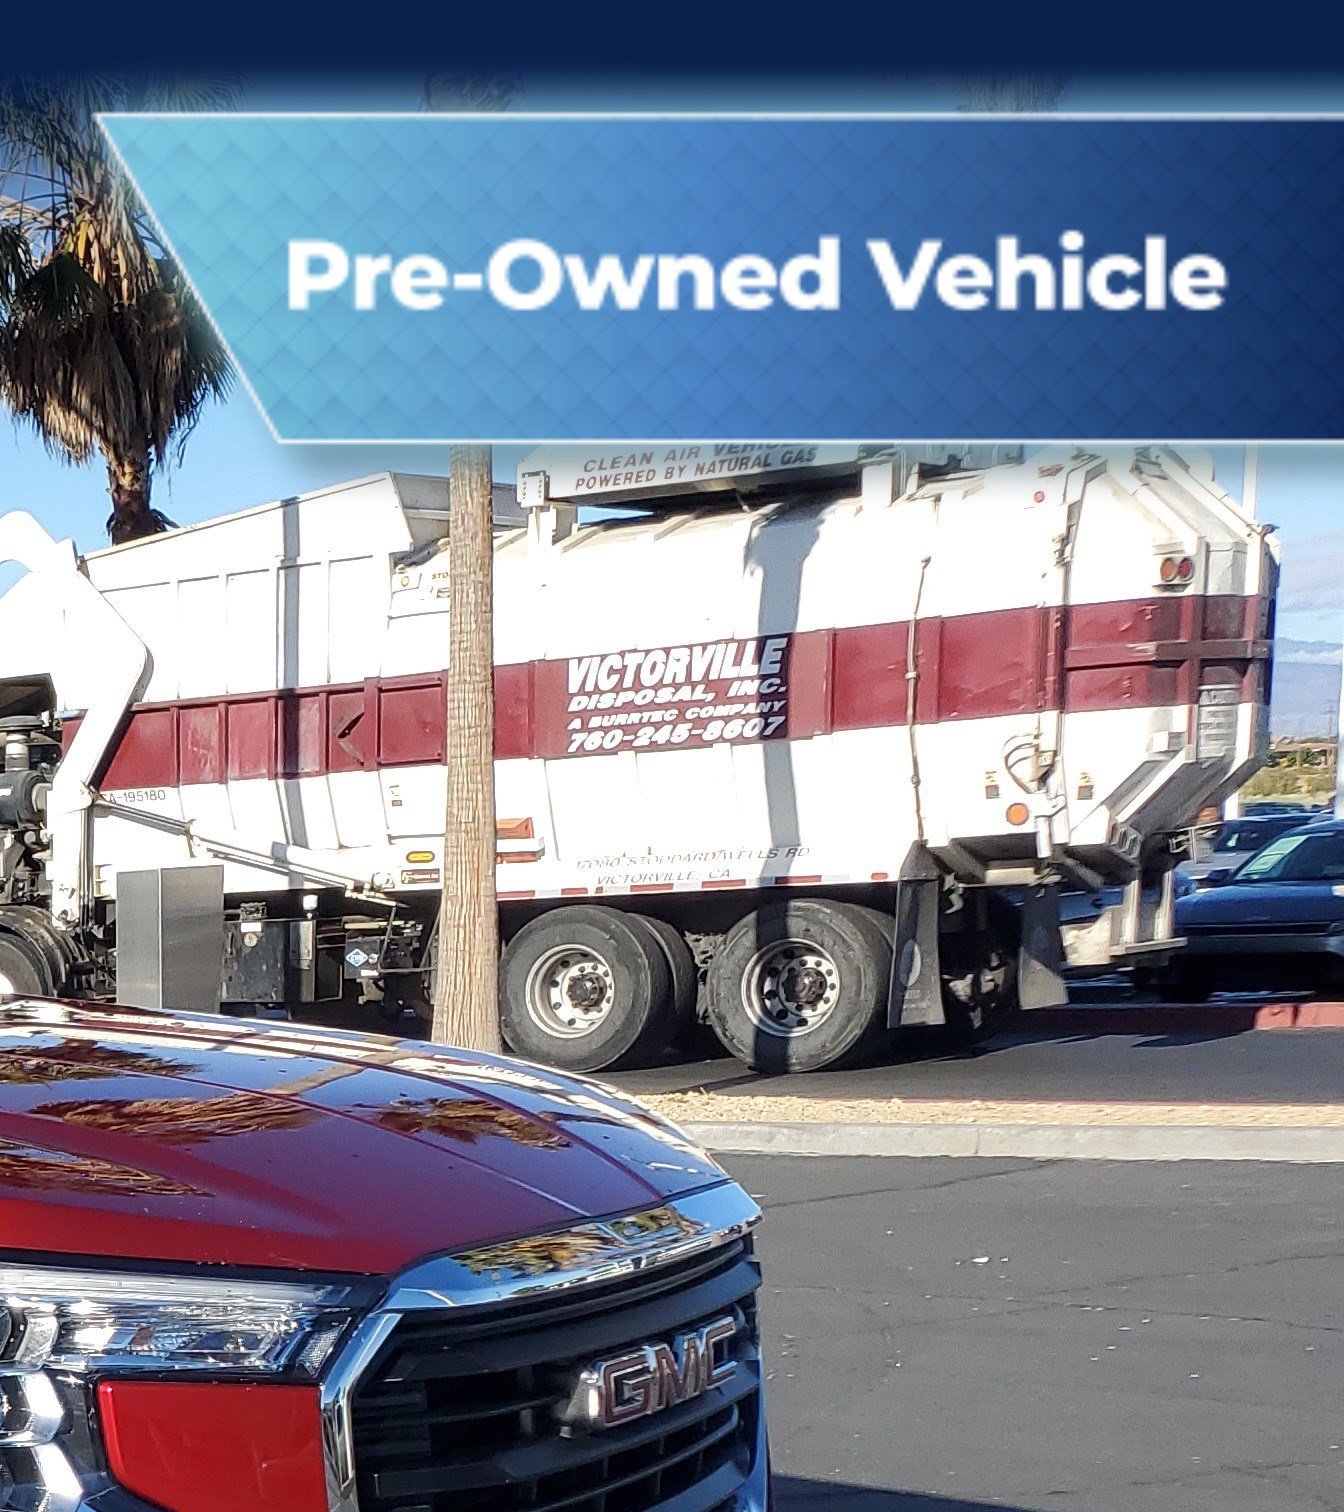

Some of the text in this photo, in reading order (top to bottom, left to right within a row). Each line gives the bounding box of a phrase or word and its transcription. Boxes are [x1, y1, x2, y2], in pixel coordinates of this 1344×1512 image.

[575, 446, 817, 491] POWERED BY NATURAL GAS
[582, 451, 654, 473] CLEAN
[664, 446, 702, 463] AIR
[567, 637, 789, 694] VICTORVILLE
[567, 677, 787, 712] DISPOSAL, INC.
[567, 700, 787, 731] A BURRTEC COMPANY
[567, 715, 786, 753] 760-245-8607
[785, 846, 810, 858] RD
[708, 868, 731, 880] CA
[592, 1315, 739, 1427] GMC
